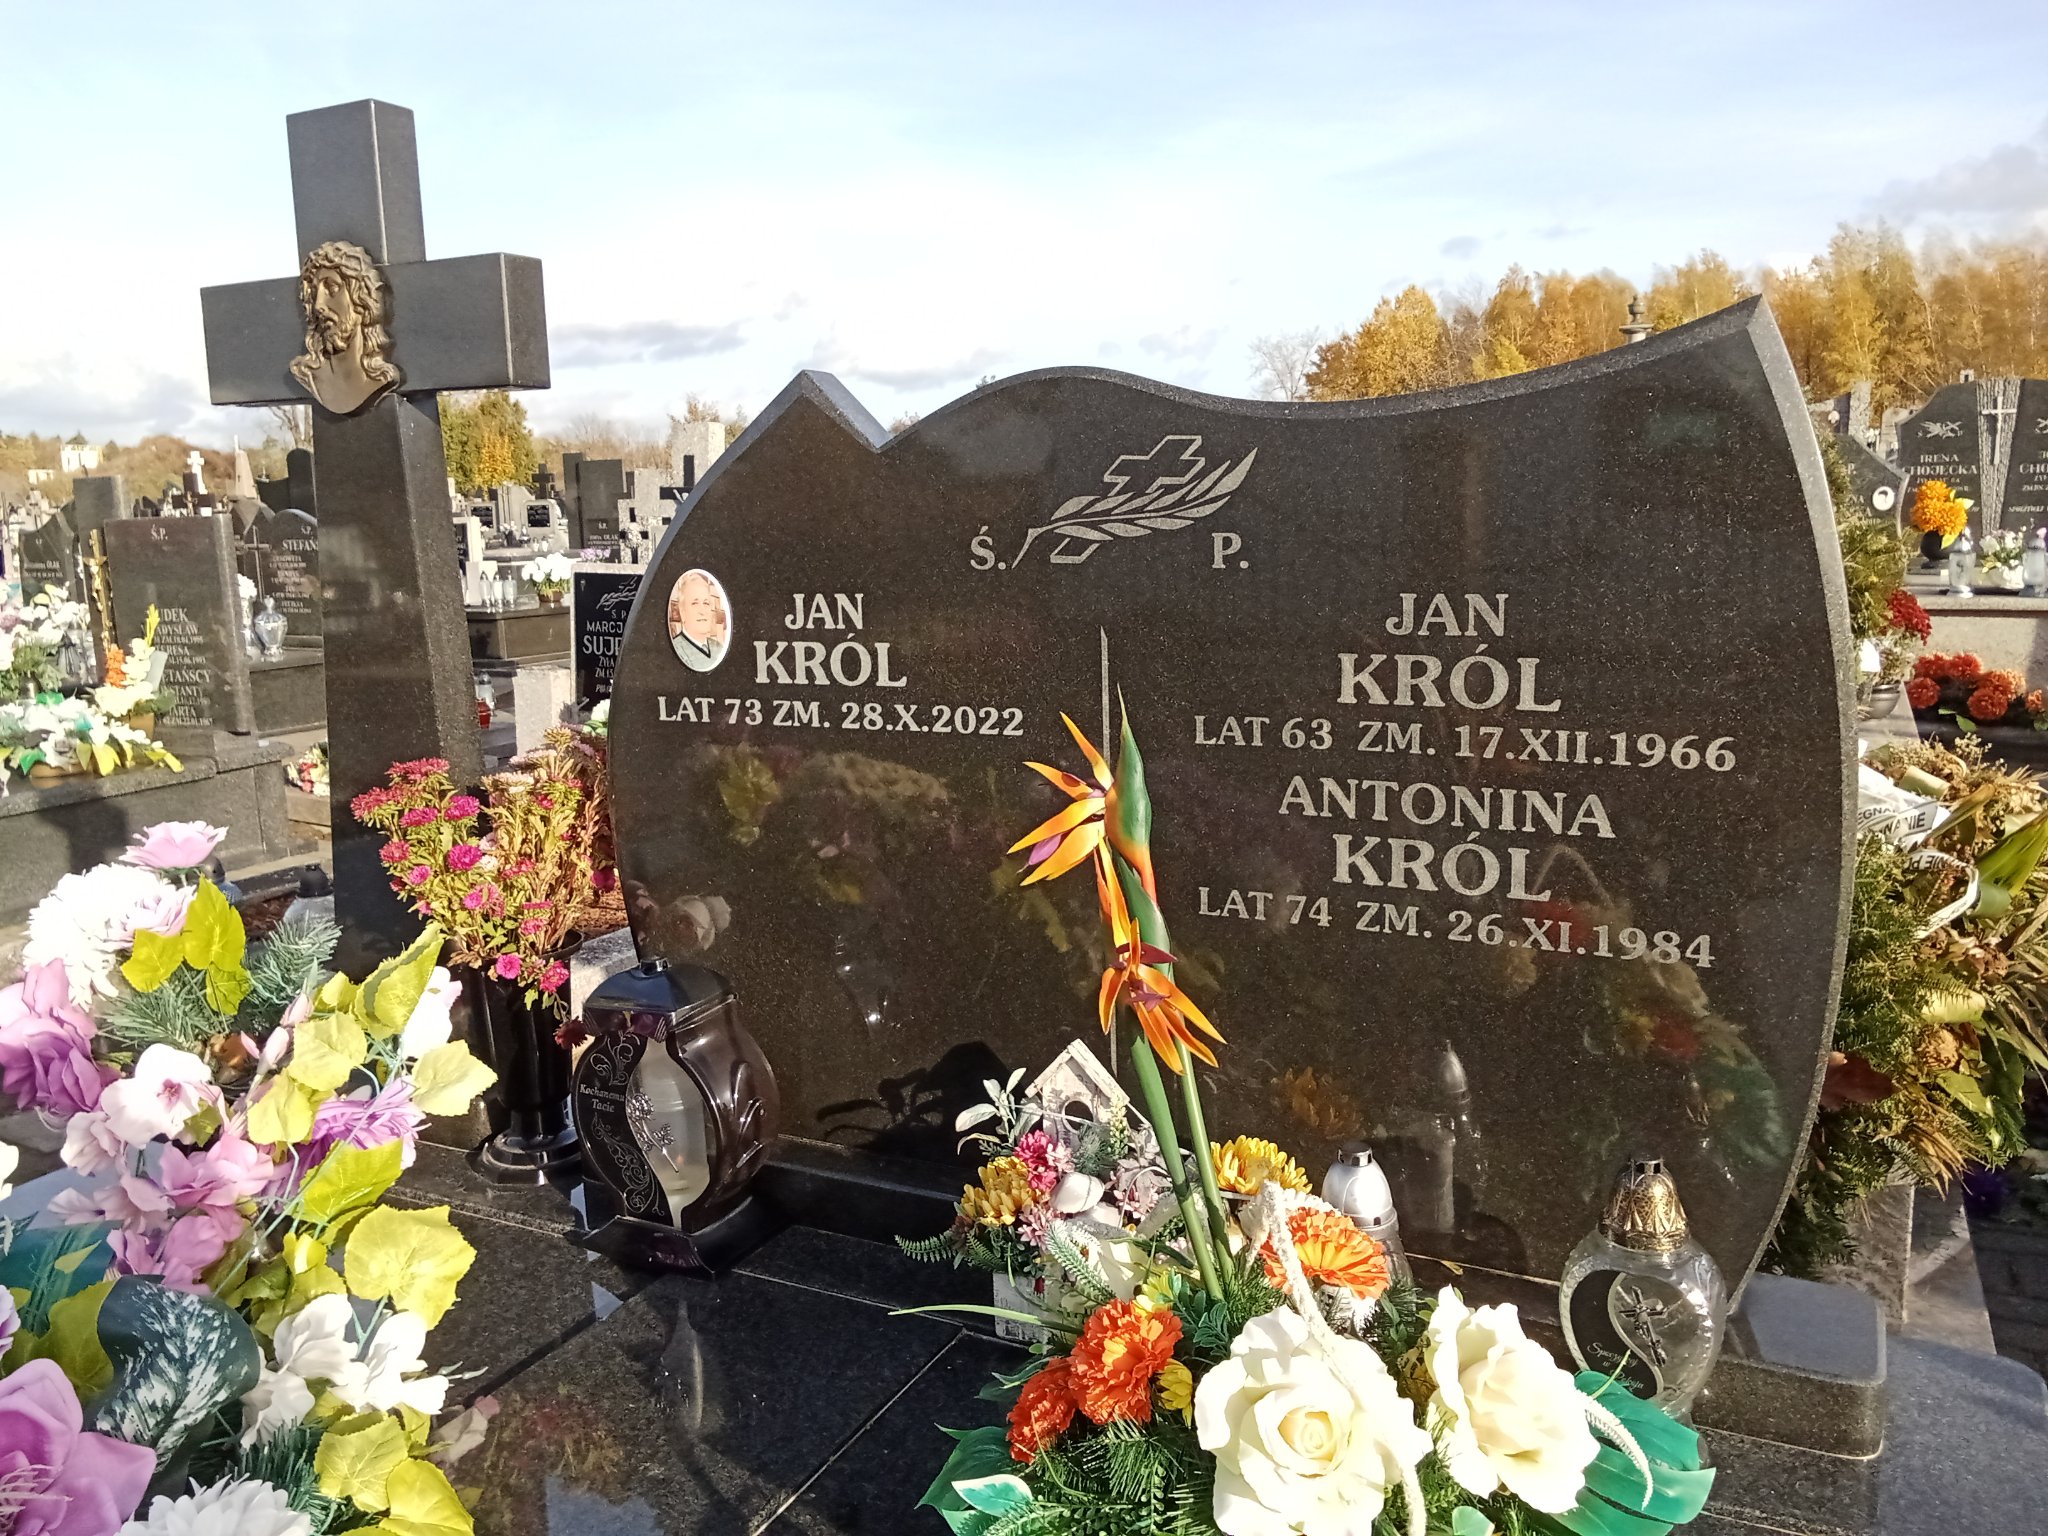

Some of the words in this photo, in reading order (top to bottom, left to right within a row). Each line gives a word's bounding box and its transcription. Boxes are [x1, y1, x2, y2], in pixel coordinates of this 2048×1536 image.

[1919, 454, 1959, 463] IRENA
[281, 537, 319, 551] STEFAŃ
[1212, 532, 1250, 569] P.
[157, 607, 188, 622] UDEK
[586, 621, 624, 633] MARCJ
[784, 592, 865, 630] JAN
[1384, 592, 1509, 638] JAN
[161, 666, 212, 683] ETAŃSCY
[753, 633, 908, 688] KRÓL
[1336, 643, 1562, 712] KRÓL
[657, 695, 715, 723] LAT
[724, 698, 763, 726] 73
[772, 700, 831, 728] ZM.
[841, 702, 1025, 737] 28.X.2022
[1193, 714, 1271, 747] LAT
[1281, 717, 1333, 751] 63
[1356, 720, 1437, 756] ZM.
[1453, 724, 1738, 772] 17.XII.1966
[1277, 775, 1617, 839] ANTONINA
[1331, 831, 1552, 903] KRÓL
[1197, 886, 1274, 921] LAT
[1285, 894, 1333, 928] 74
[1355, 900, 1433, 939] ZM.
[1447, 909, 1716, 969] 26.XI.1984
[579, 1083, 625, 1101] Kochanemu
